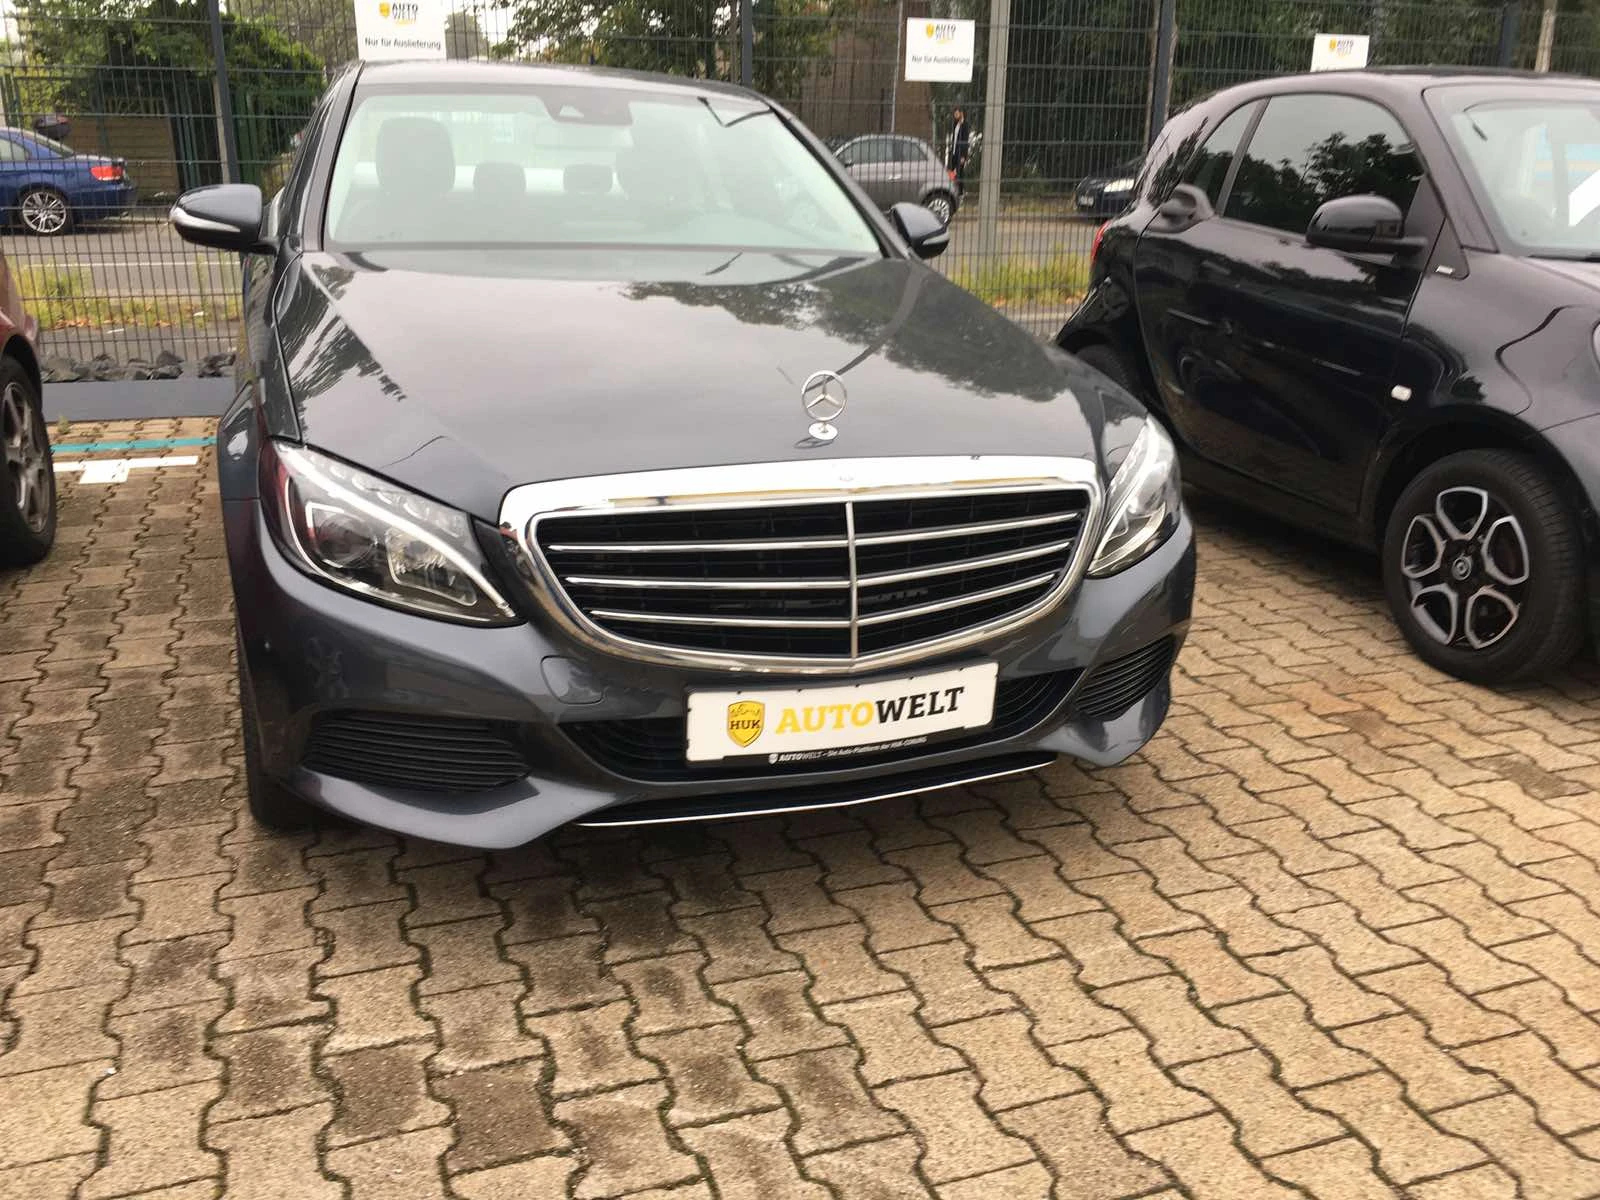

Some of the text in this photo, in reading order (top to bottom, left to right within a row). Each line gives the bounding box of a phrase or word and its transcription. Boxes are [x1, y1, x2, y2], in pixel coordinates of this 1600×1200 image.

[364, 37, 441, 50] Nur für Auslieferung
[912, 55, 922, 64] Nur
[933, 56, 970, 65] Auslieferung
[775, 686, 965, 735] AUTOWELT
[730, 719, 761, 730] HUK
[778, 751, 823, 762] AUTOWELT
